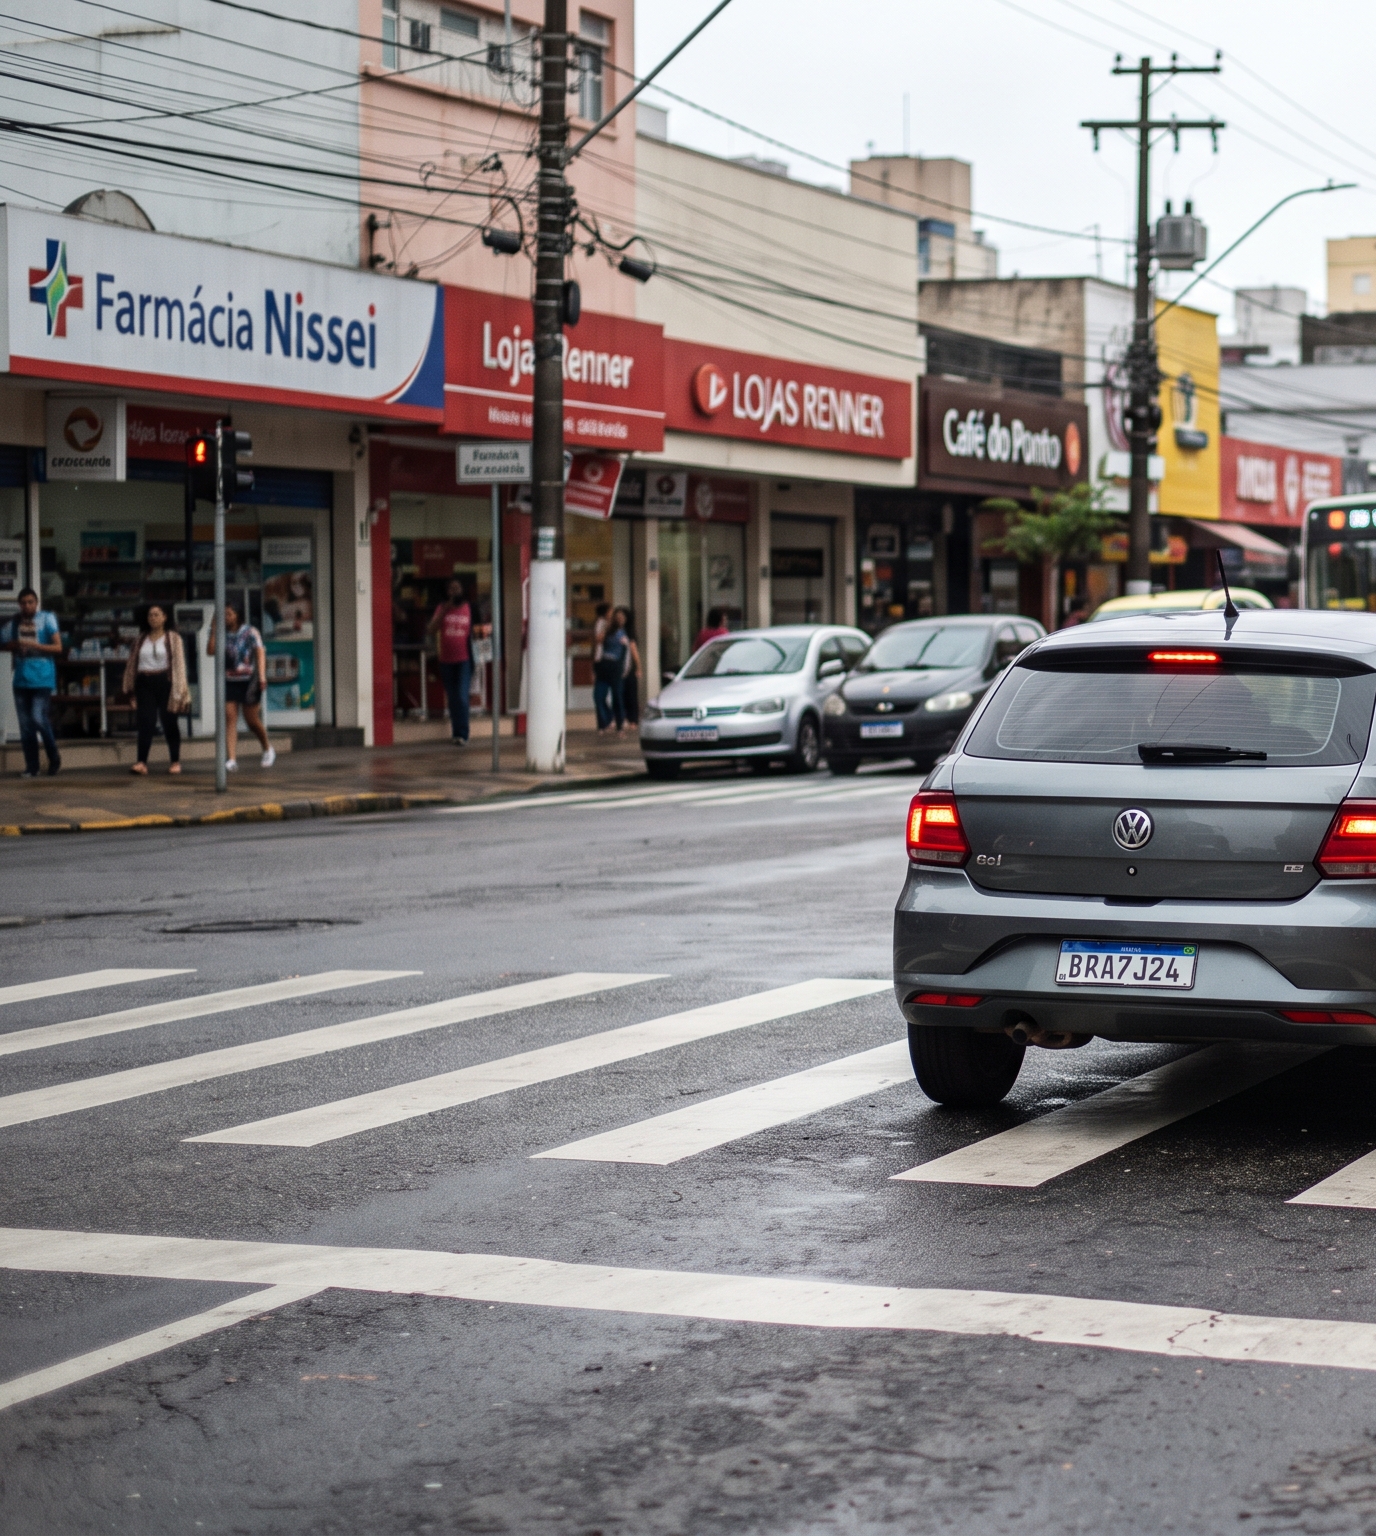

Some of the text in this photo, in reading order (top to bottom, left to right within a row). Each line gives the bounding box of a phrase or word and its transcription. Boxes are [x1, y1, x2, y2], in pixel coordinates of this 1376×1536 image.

[96, 271, 377, 370] Farmácia Nissei
[732, 371, 885, 440] LOJAS RENNER
[943, 407, 986, 460] Café
[987, 411, 1011, 463] do
[1068, 954, 1179, 983] BRA7J24
